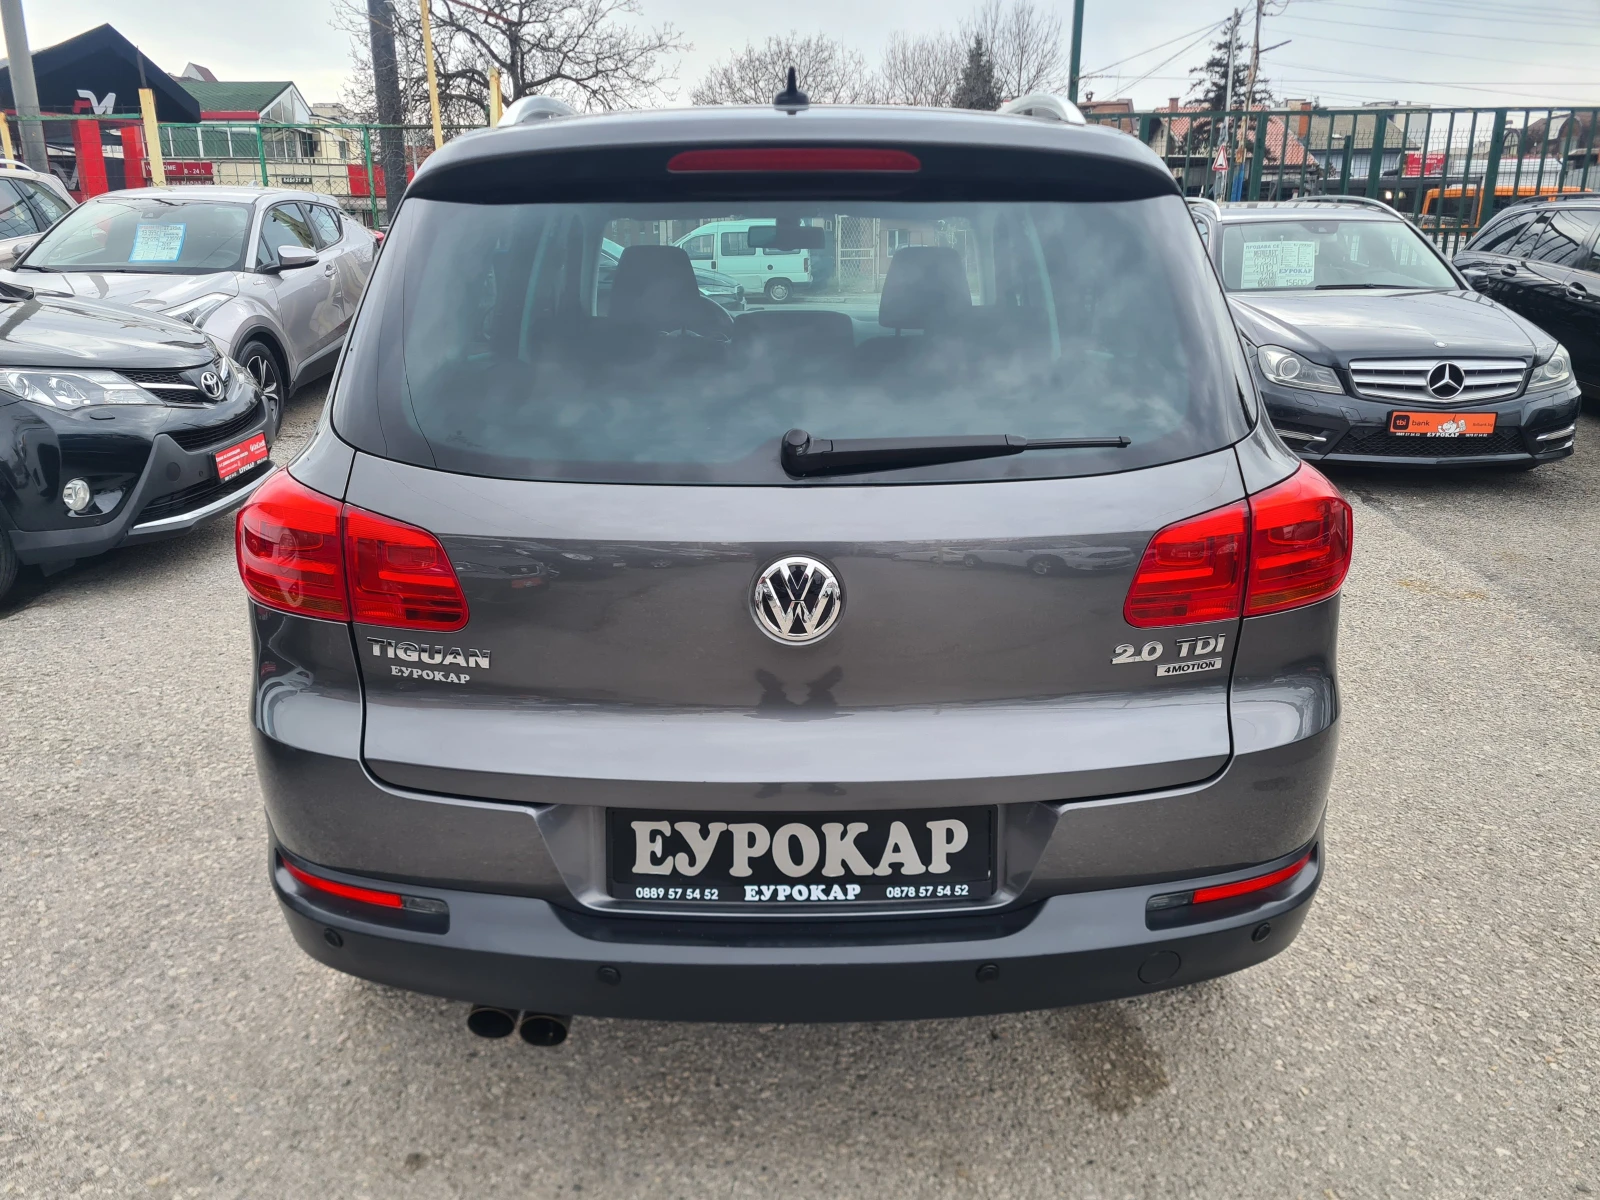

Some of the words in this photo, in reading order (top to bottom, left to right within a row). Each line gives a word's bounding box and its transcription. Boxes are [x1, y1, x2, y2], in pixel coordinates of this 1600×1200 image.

[366, 636, 491, 669] TIGUAN
[1111, 640, 1164, 664] 2.0
[1176, 633, 1226, 657] TDI
[390, 665, 471, 684] ЕУРОКАР
[1163, 661, 1216, 674] 4MOTION
[630, 818, 969, 877] ЕУРОКАР
[635, 887, 664, 899] 0889
[667, 887, 683, 900] 57
[685, 888, 701, 900] 54
[703, 889, 719, 900] 52
[743, 884, 861, 901] ЕУРОКАР
[886, 886, 916, 898] 0878
[918, 886, 934, 897] 57
[936, 885, 952, 896] 54
[954, 884, 969, 896] 52
